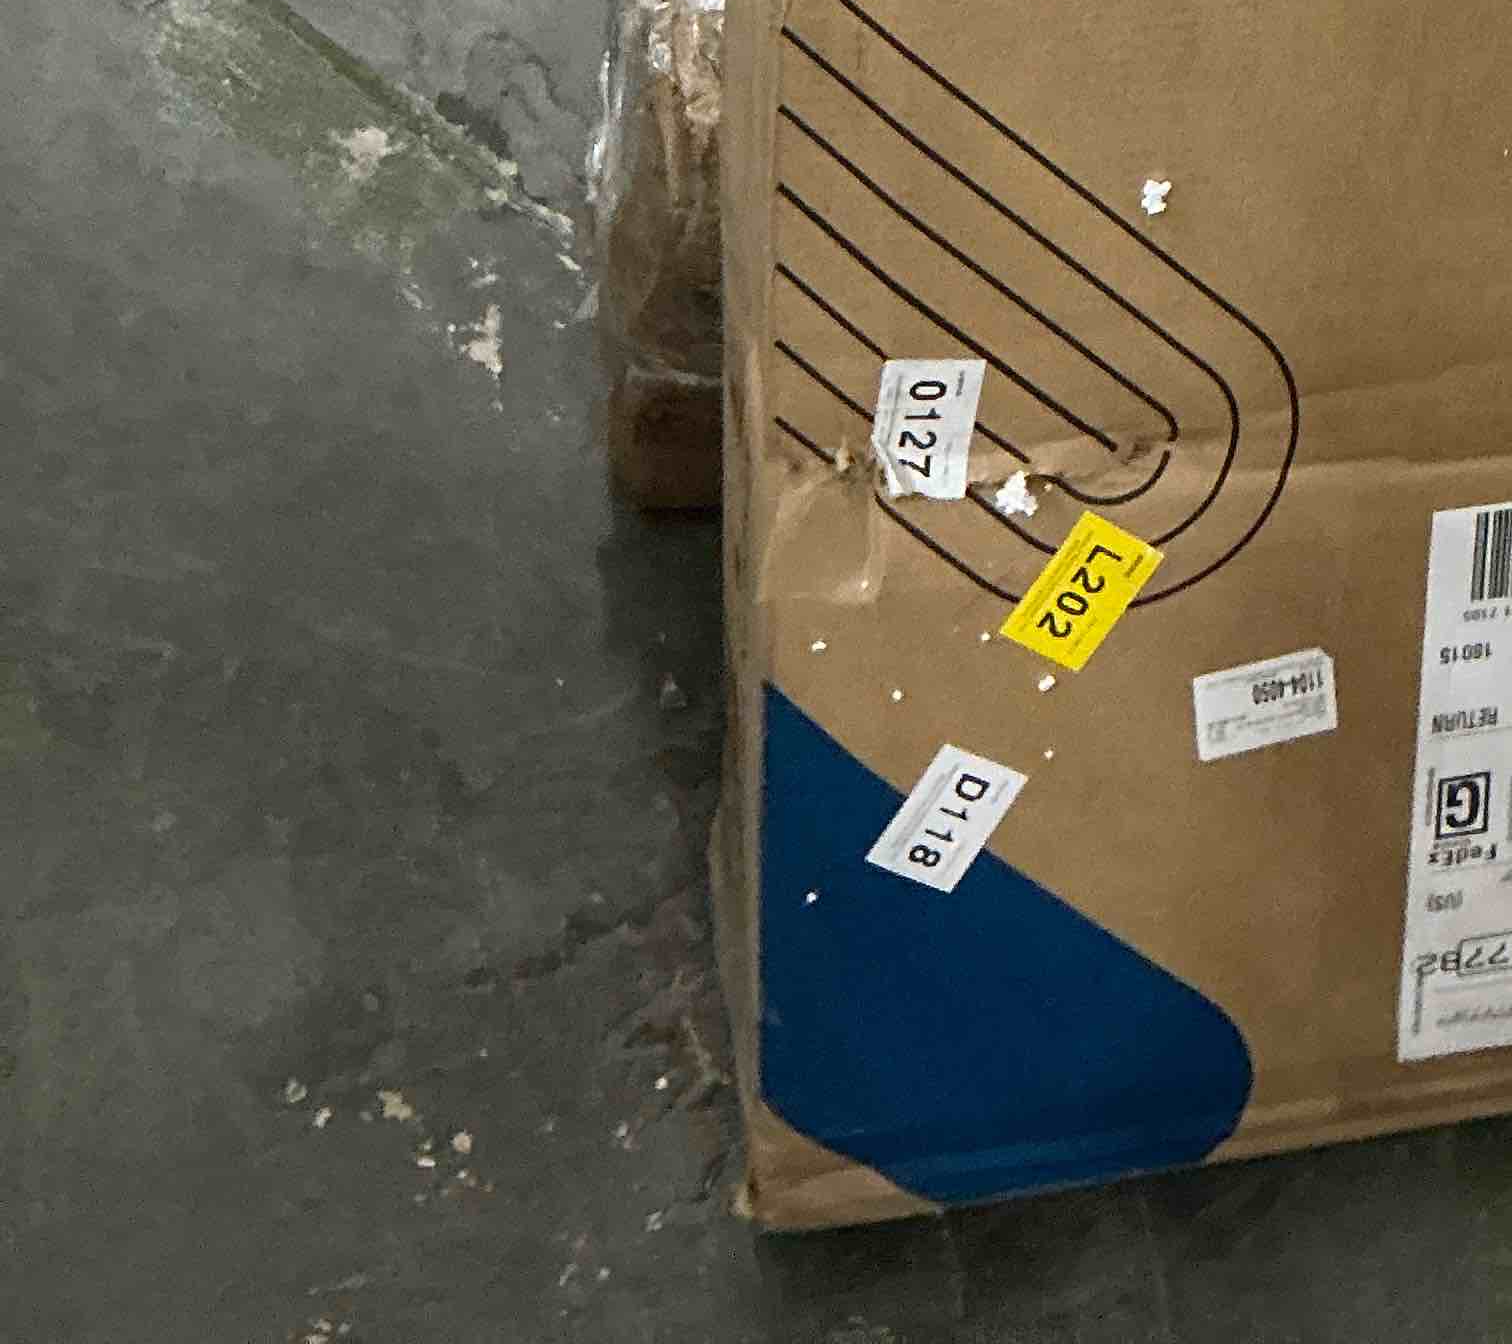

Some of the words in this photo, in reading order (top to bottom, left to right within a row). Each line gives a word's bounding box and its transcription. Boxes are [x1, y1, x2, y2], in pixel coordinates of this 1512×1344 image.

[897, 379, 948, 480] 0127
[1036, 542, 1122, 640] L202
[1430, 704, 1498, 735] RETURN
[907, 771, 990, 869] D118
[1446, 780, 1482, 827] G
[1426, 841, 1498, 871] FedEx
